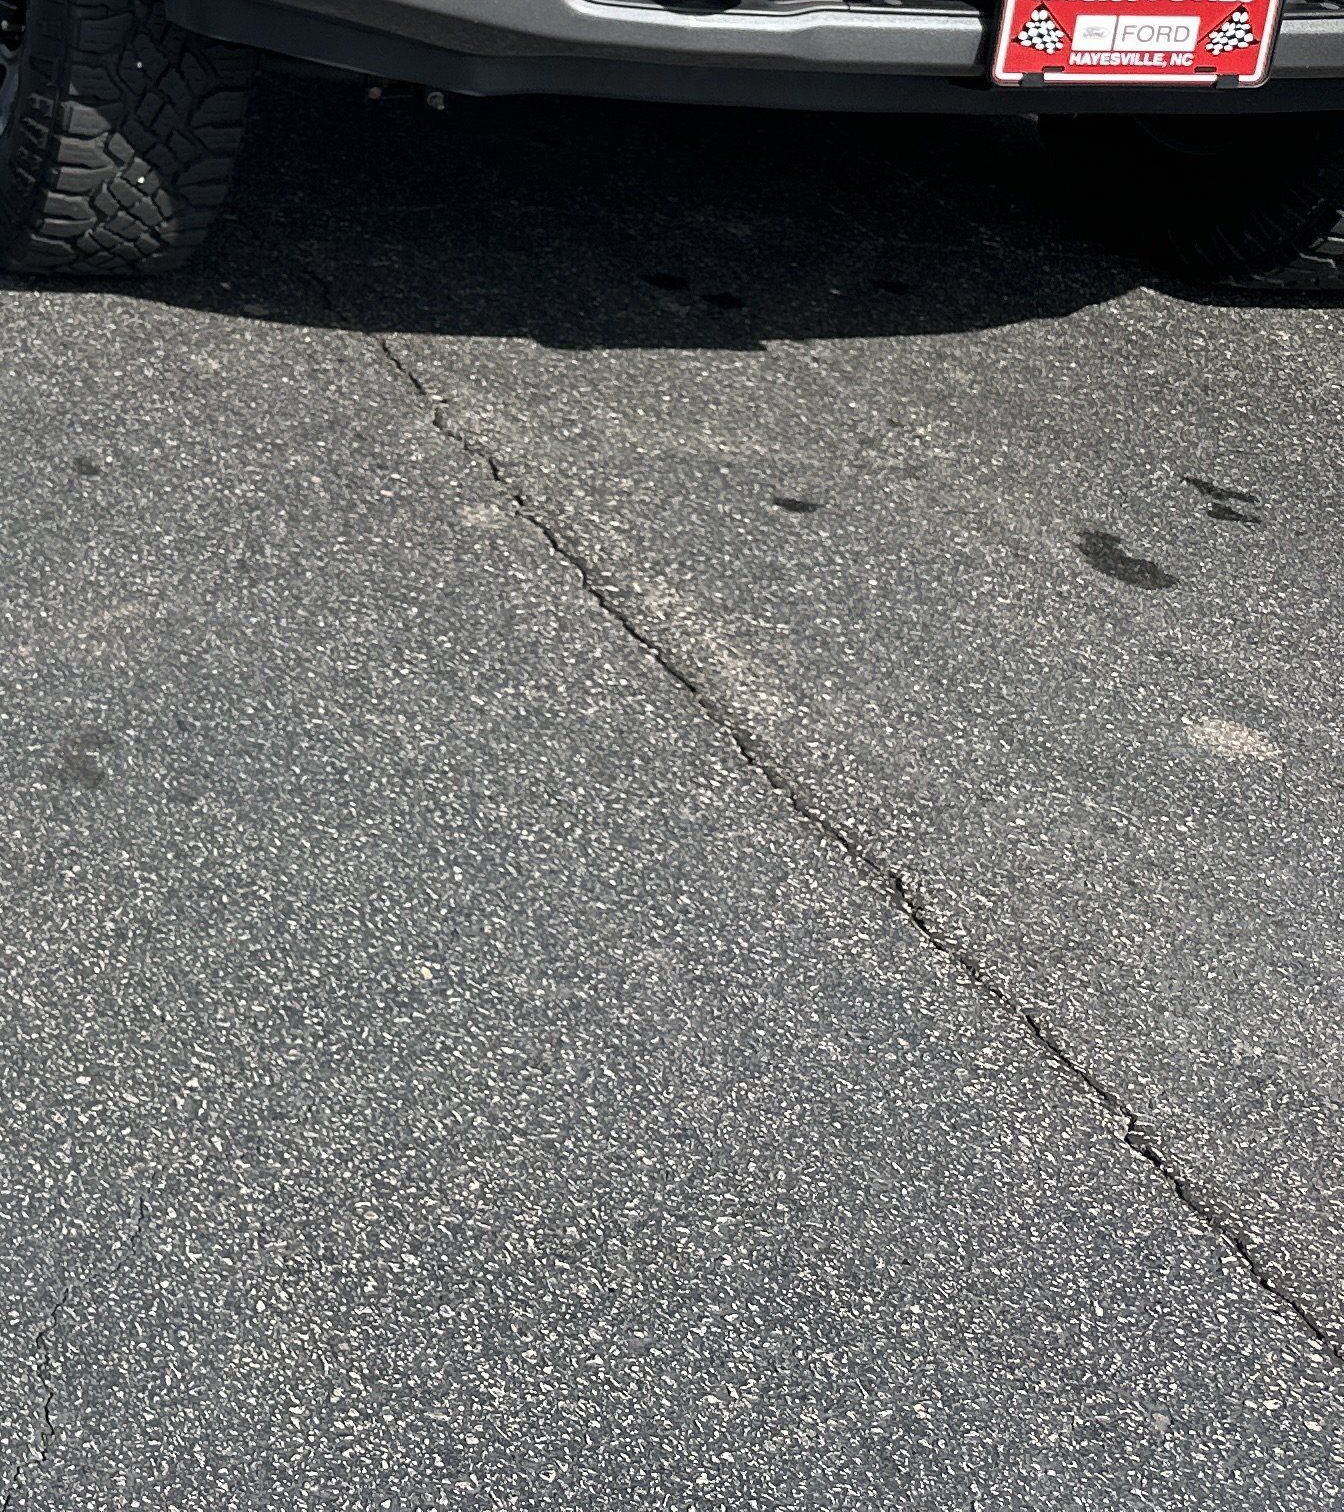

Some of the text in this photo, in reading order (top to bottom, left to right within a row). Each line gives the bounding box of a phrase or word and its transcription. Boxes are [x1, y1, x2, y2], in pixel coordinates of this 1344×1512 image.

[1121, 24, 1191, 43] FORD
[1069, 51, 1195, 68] HAYESVILLE, NC
